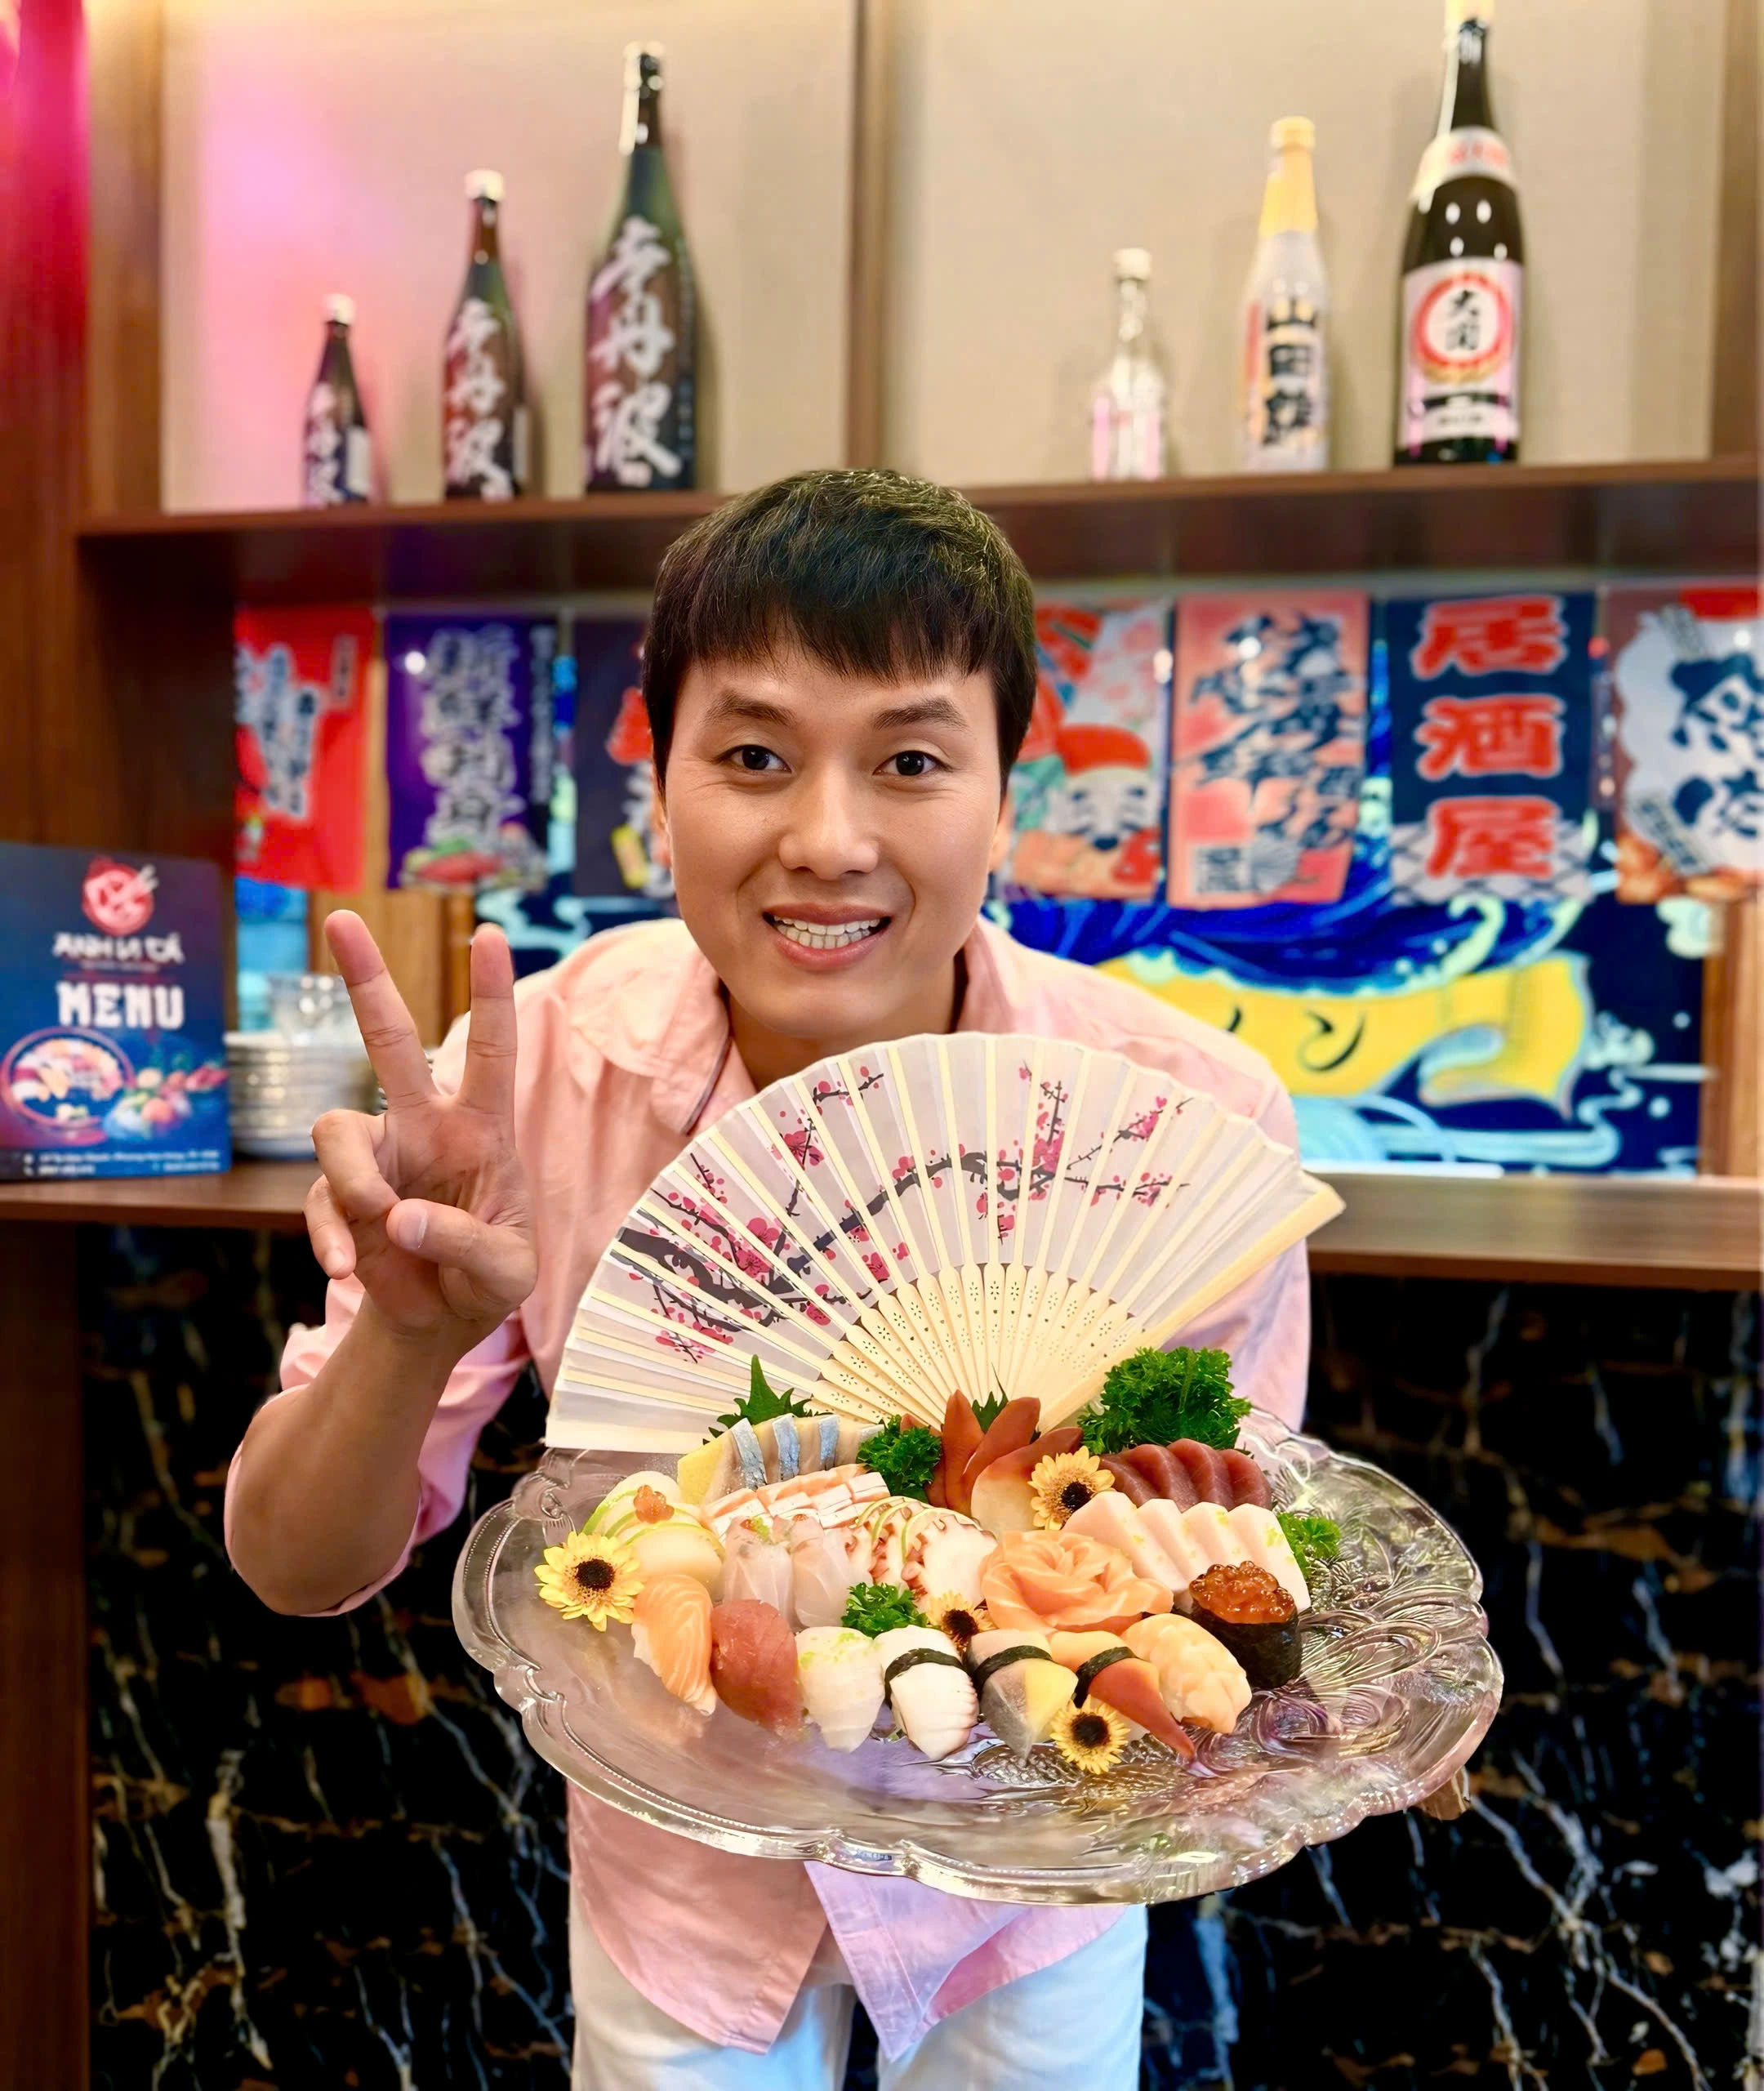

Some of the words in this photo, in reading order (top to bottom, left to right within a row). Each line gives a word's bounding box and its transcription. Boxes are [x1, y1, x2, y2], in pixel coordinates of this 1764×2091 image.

[1411, 595, 1570, 881] 居酒屋
[56, 980, 185, 1029] MENU
